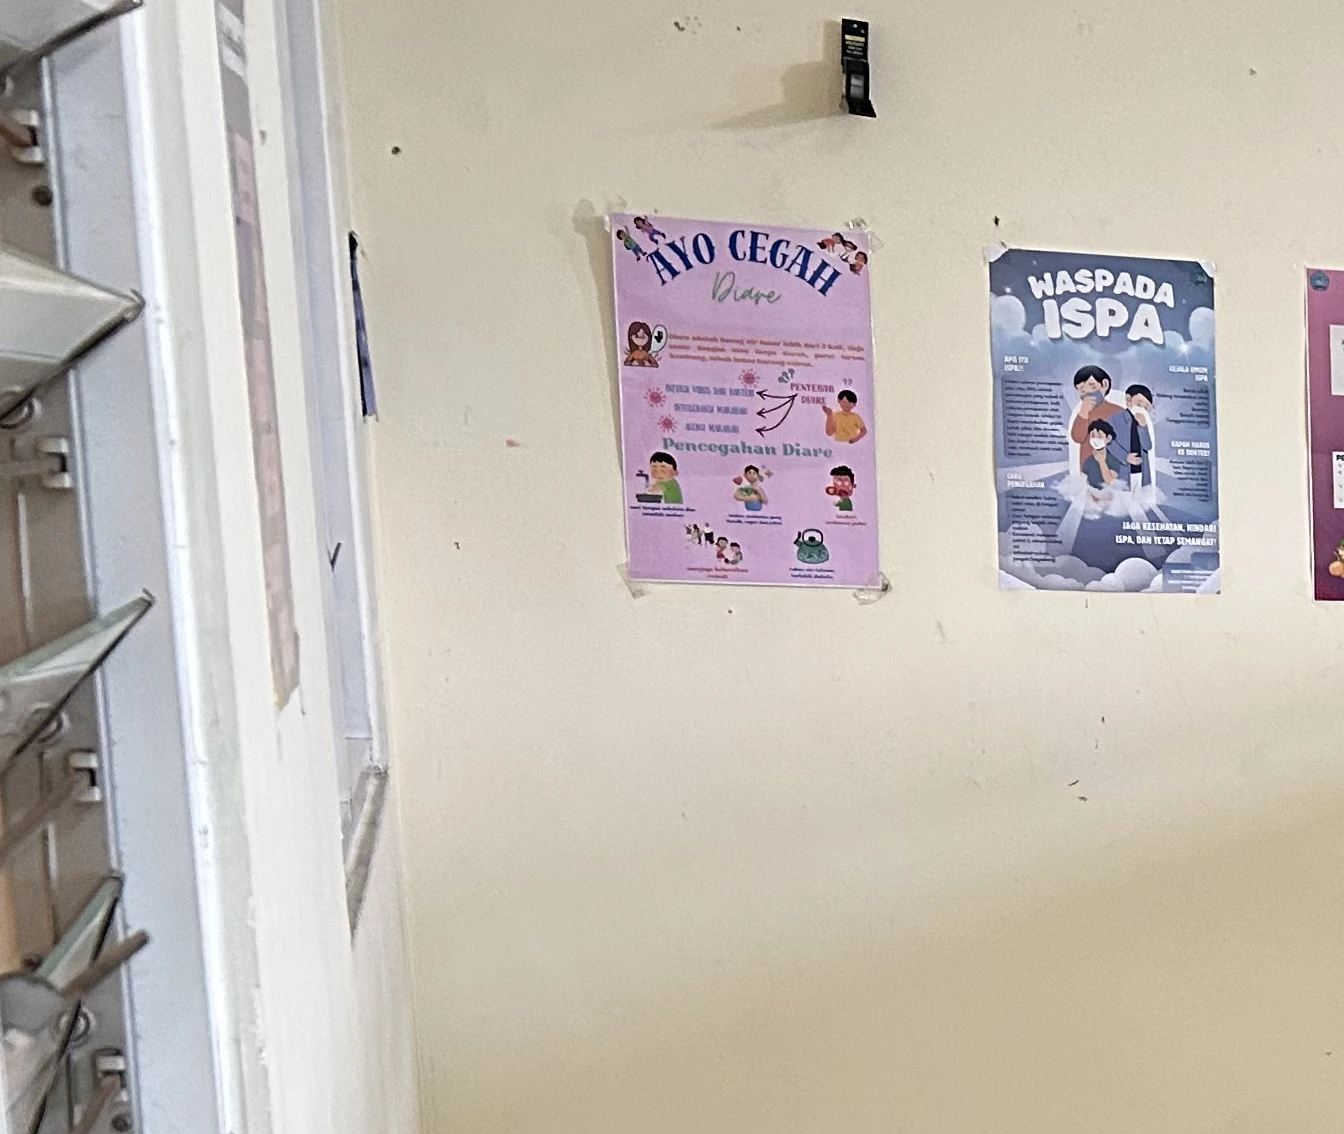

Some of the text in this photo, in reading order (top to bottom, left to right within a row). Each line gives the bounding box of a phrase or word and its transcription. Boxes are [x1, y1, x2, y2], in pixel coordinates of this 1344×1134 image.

[646, 230, 841, 296] AYO CEGAH
[711, 271, 781, 305] Diare
[1027, 269, 1175, 308] WASPADA
[1042, 297, 1165, 345] ISPA
[662, 437, 833, 458] Pencegahan Diare
